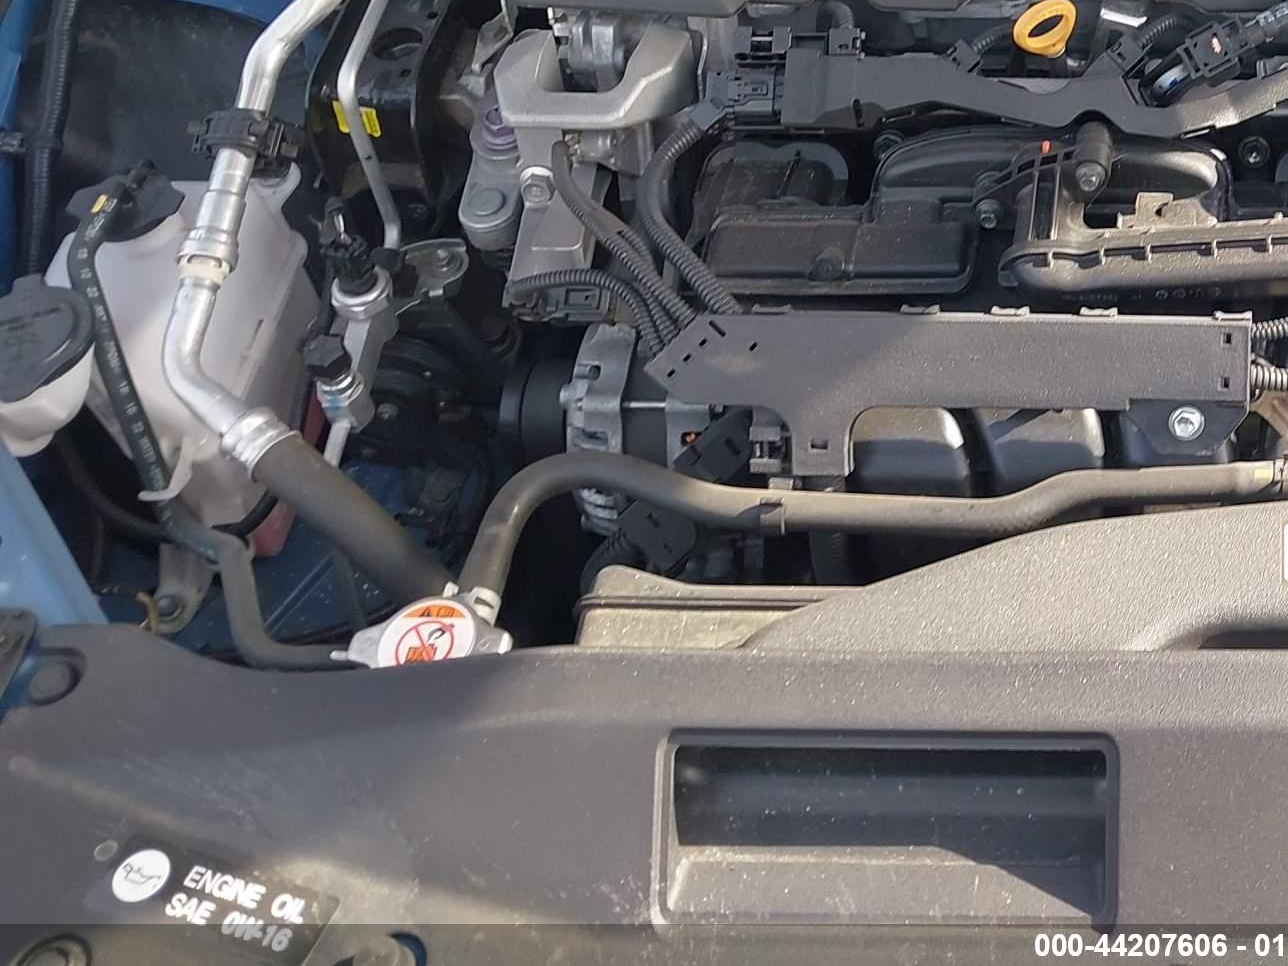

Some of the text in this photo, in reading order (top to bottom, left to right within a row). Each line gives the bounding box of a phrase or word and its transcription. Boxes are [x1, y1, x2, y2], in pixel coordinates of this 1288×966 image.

[165, 892, 293, 952] SAE 0W-16
[183, 865, 306, 924] ENGINE OIL
